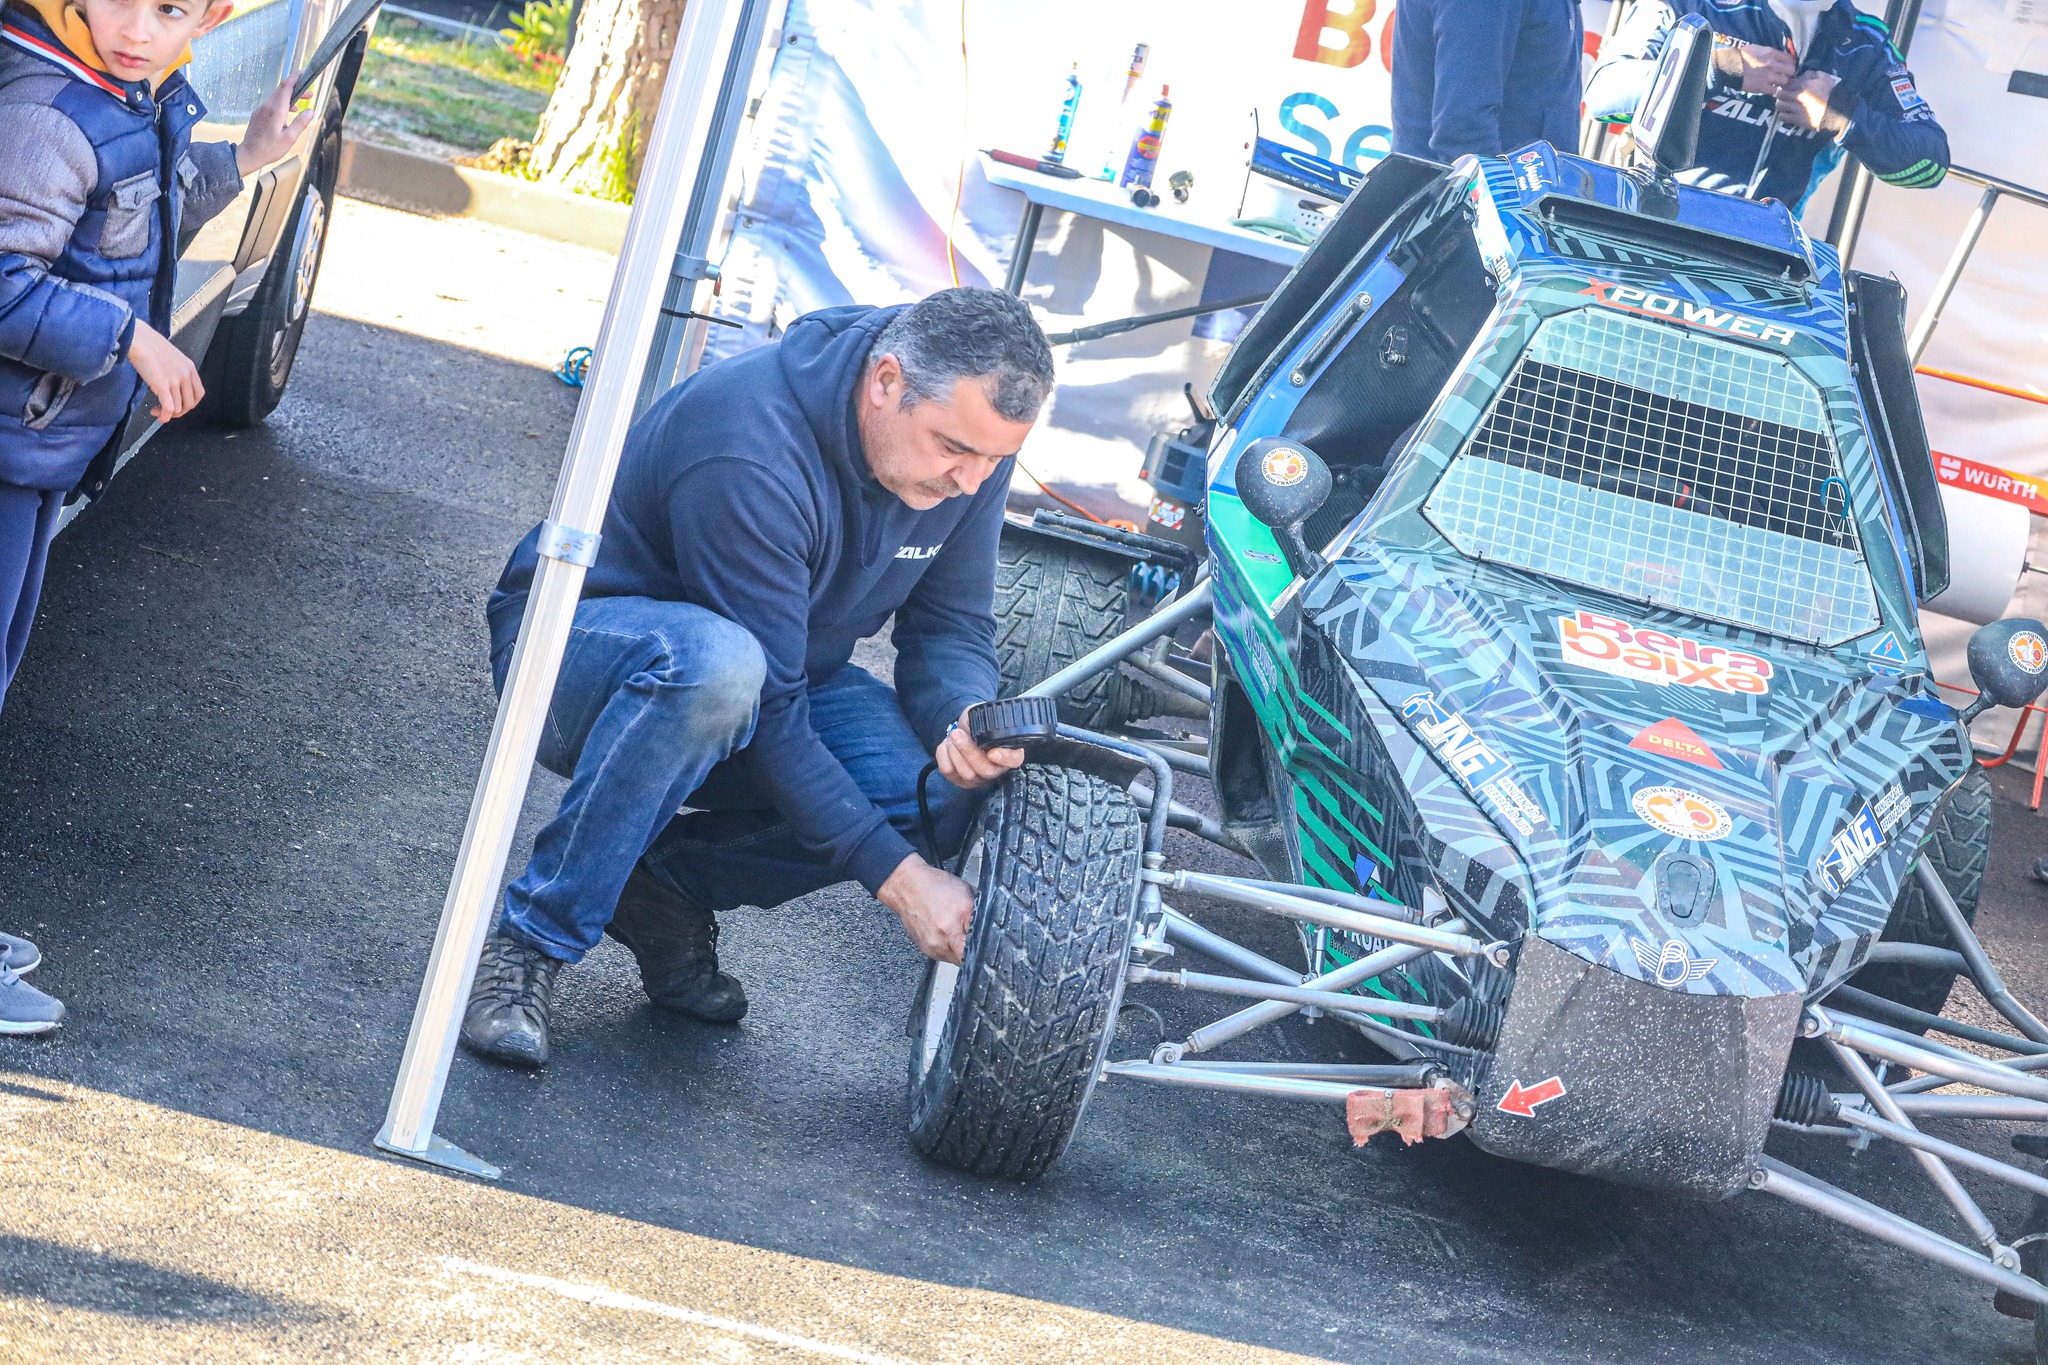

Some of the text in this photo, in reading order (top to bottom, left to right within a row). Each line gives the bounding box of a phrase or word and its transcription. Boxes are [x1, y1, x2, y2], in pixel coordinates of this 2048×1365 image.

[1578, 276, 1797, 347] XPOWER
[1964, 465, 2039, 500] WÜRTH
[1414, 712, 1498, 777] JNG
[1648, 734, 1707, 756] DELTA
[1837, 812, 1878, 881] JNG
